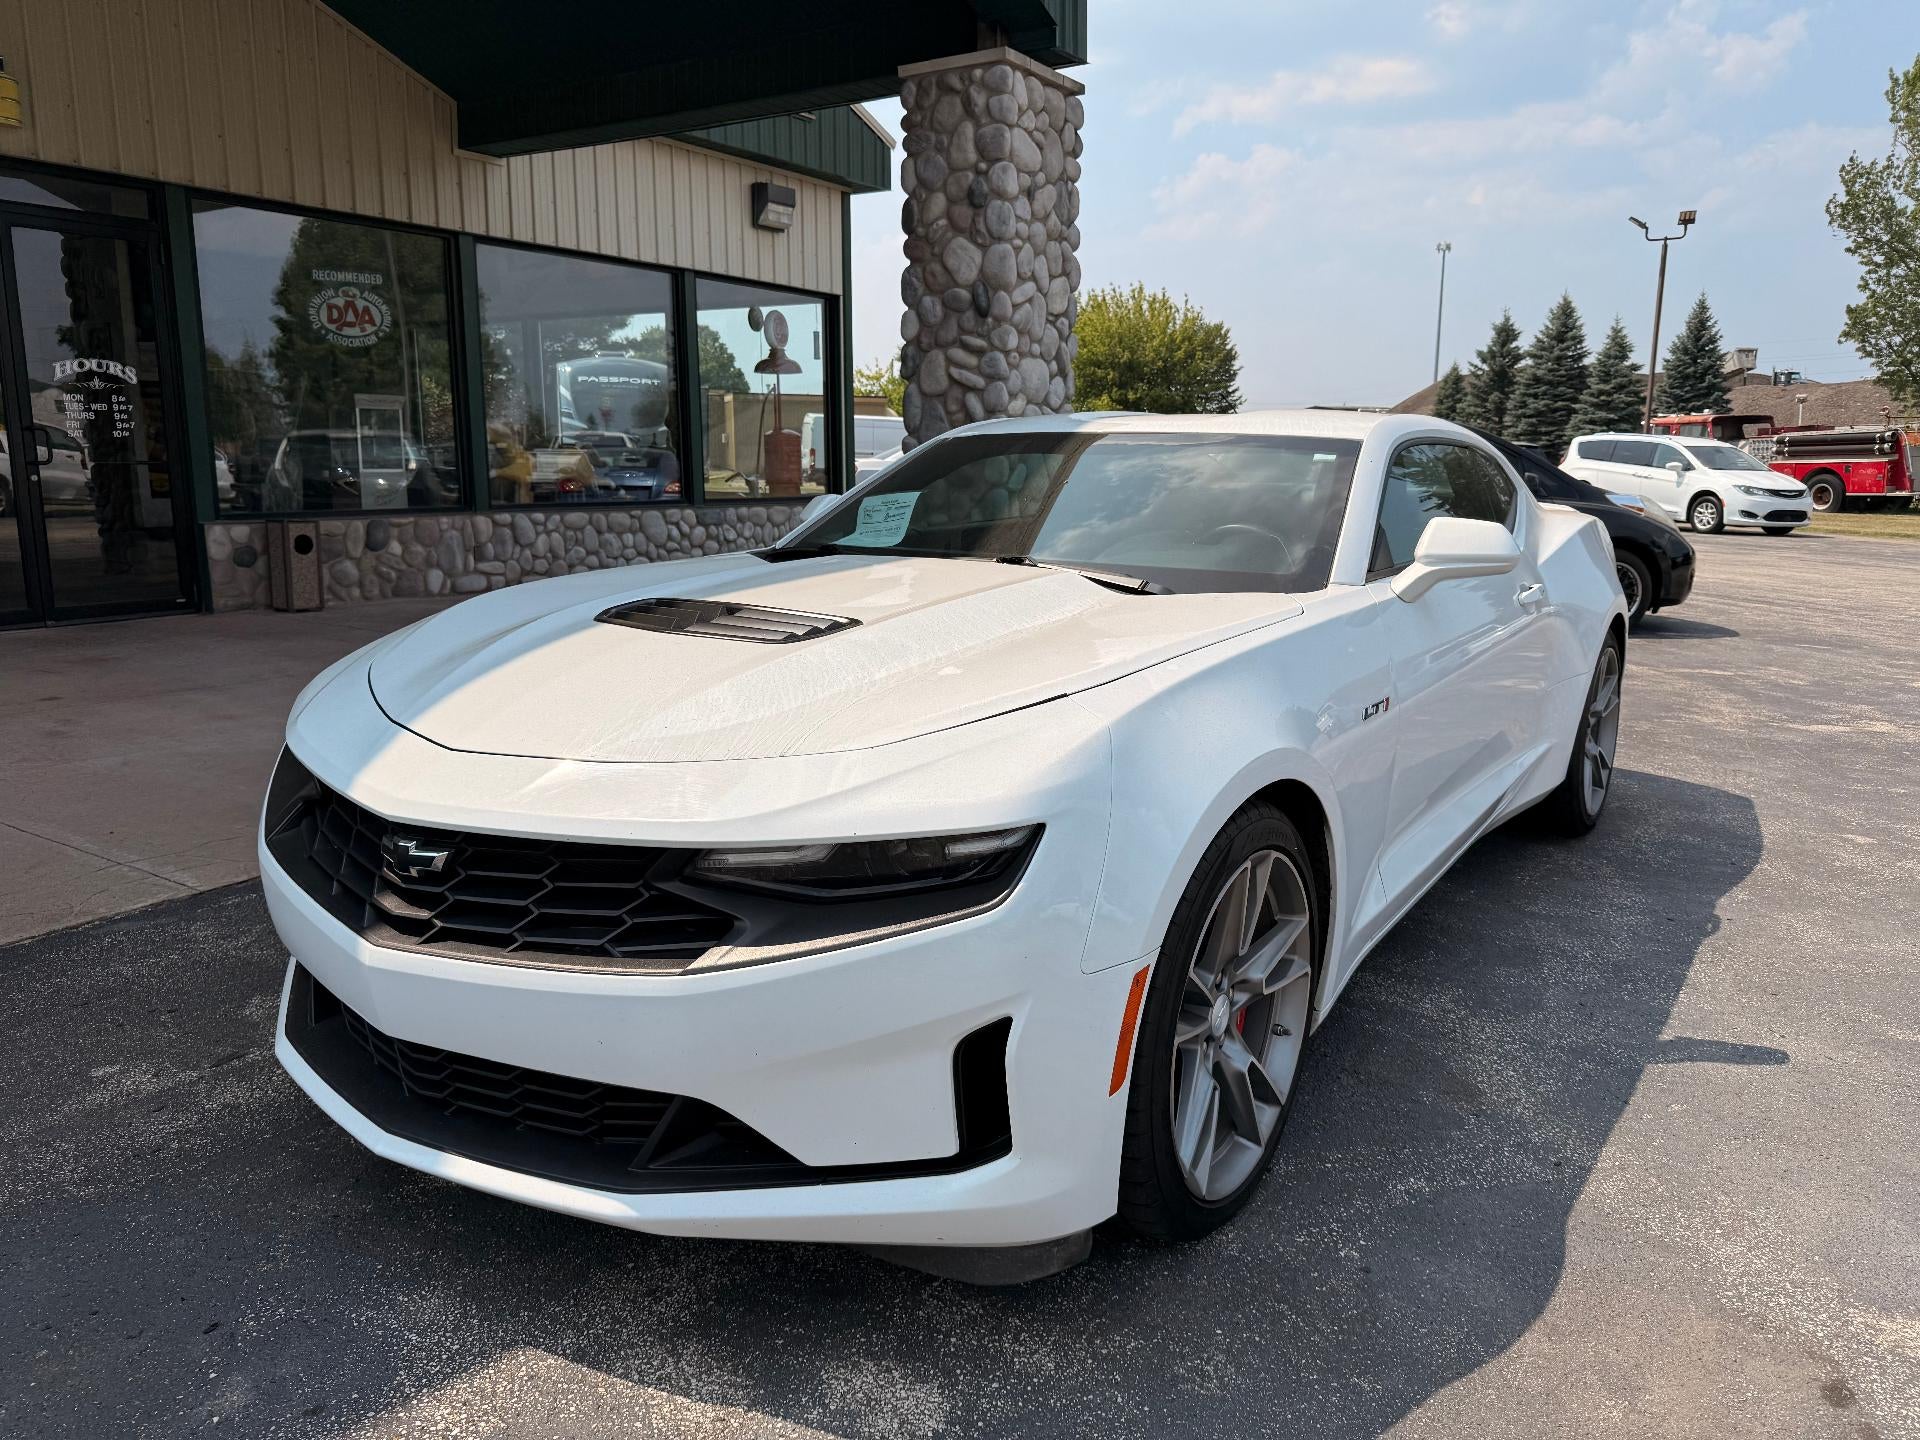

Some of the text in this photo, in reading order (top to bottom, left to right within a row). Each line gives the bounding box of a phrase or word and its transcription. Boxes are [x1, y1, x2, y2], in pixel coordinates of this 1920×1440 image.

[312, 269, 383, 284] RECOMMENDED
[308, 287, 392, 332] DOMINION AUTOMOBILE
[326, 299, 377, 333] DAA
[326, 332, 379, 347] ASSOCIATION
[53, 358, 138, 384] HOURS
[577, 376, 661, 385] PASSPORT
[63, 393, 84, 402] MON
[111, 394, 118, 402] 8
[112, 403, 119, 411] 9
[127, 404, 134, 412] 7
[65, 411, 95, 420] THURS
[114, 412, 120, 420] 9
[66, 420, 80, 429] FRI
[116, 421, 122, 429] 9
[67, 429, 84, 438] SAT
[112, 430, 122, 438] 10
[1361, 696, 1390, 721] LT1
